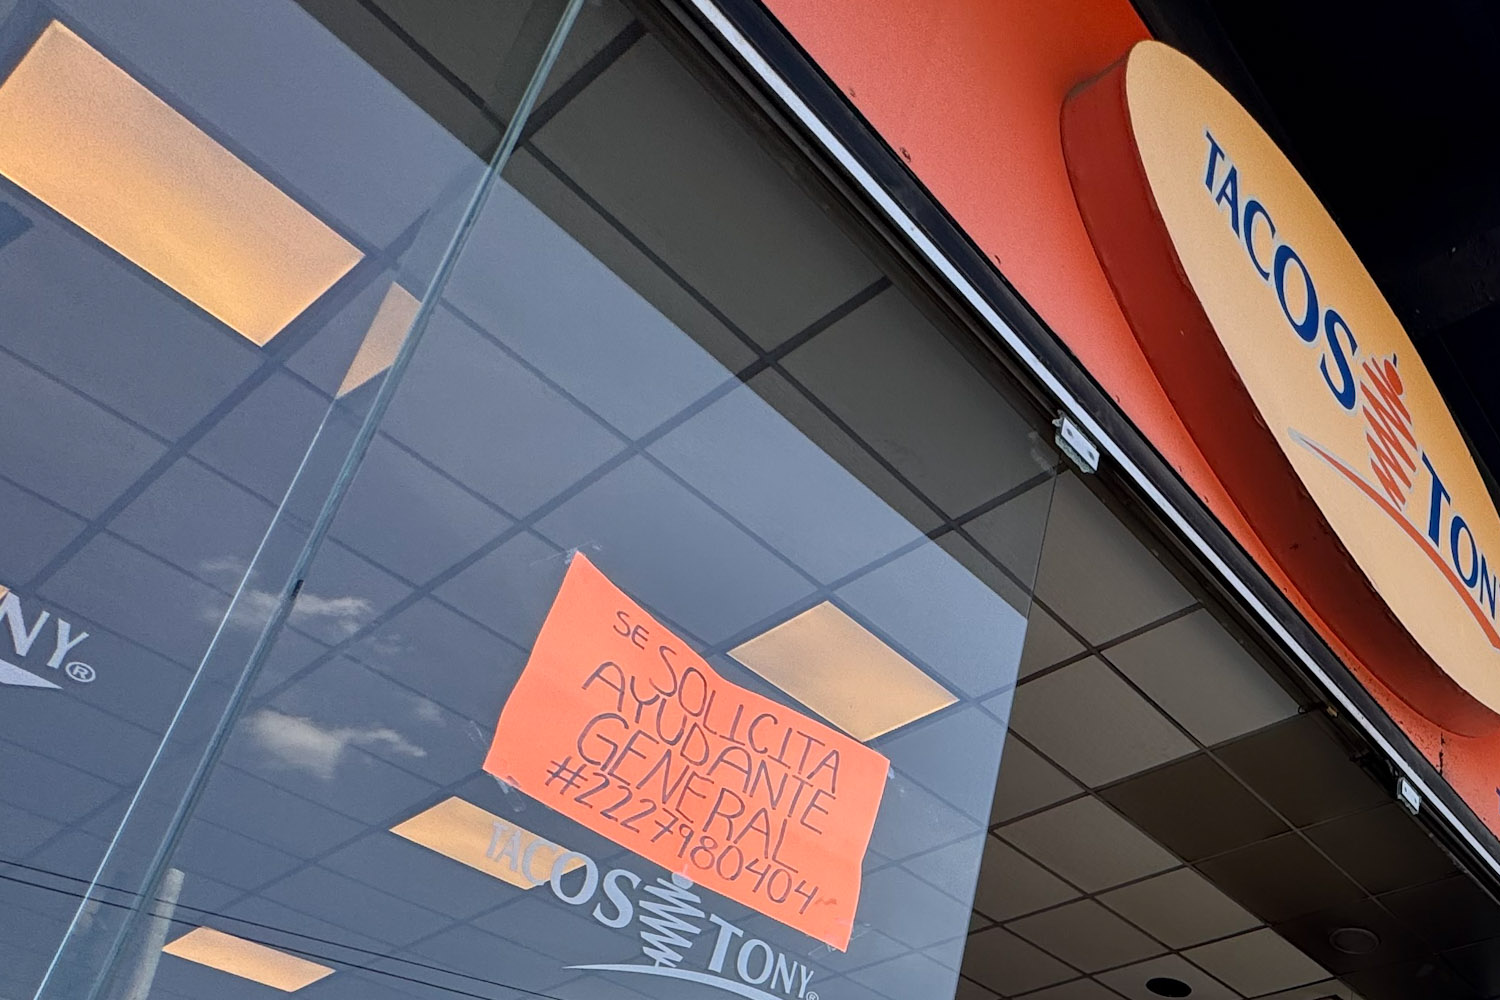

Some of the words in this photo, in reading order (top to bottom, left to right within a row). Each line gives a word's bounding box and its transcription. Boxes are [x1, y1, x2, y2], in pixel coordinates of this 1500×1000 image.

[1205, 129, 1359, 412] TACOS
[581, 660, 837, 836] AYUDANTE
[612, 610, 650, 650] SE
[649, 645, 840, 794] SOLICITA
[545, 755, 819, 915] #2227980404
[577, 712, 799, 874] GENERAL
[486, 819, 643, 929] TACOS
[708, 912, 815, 999] TONY
